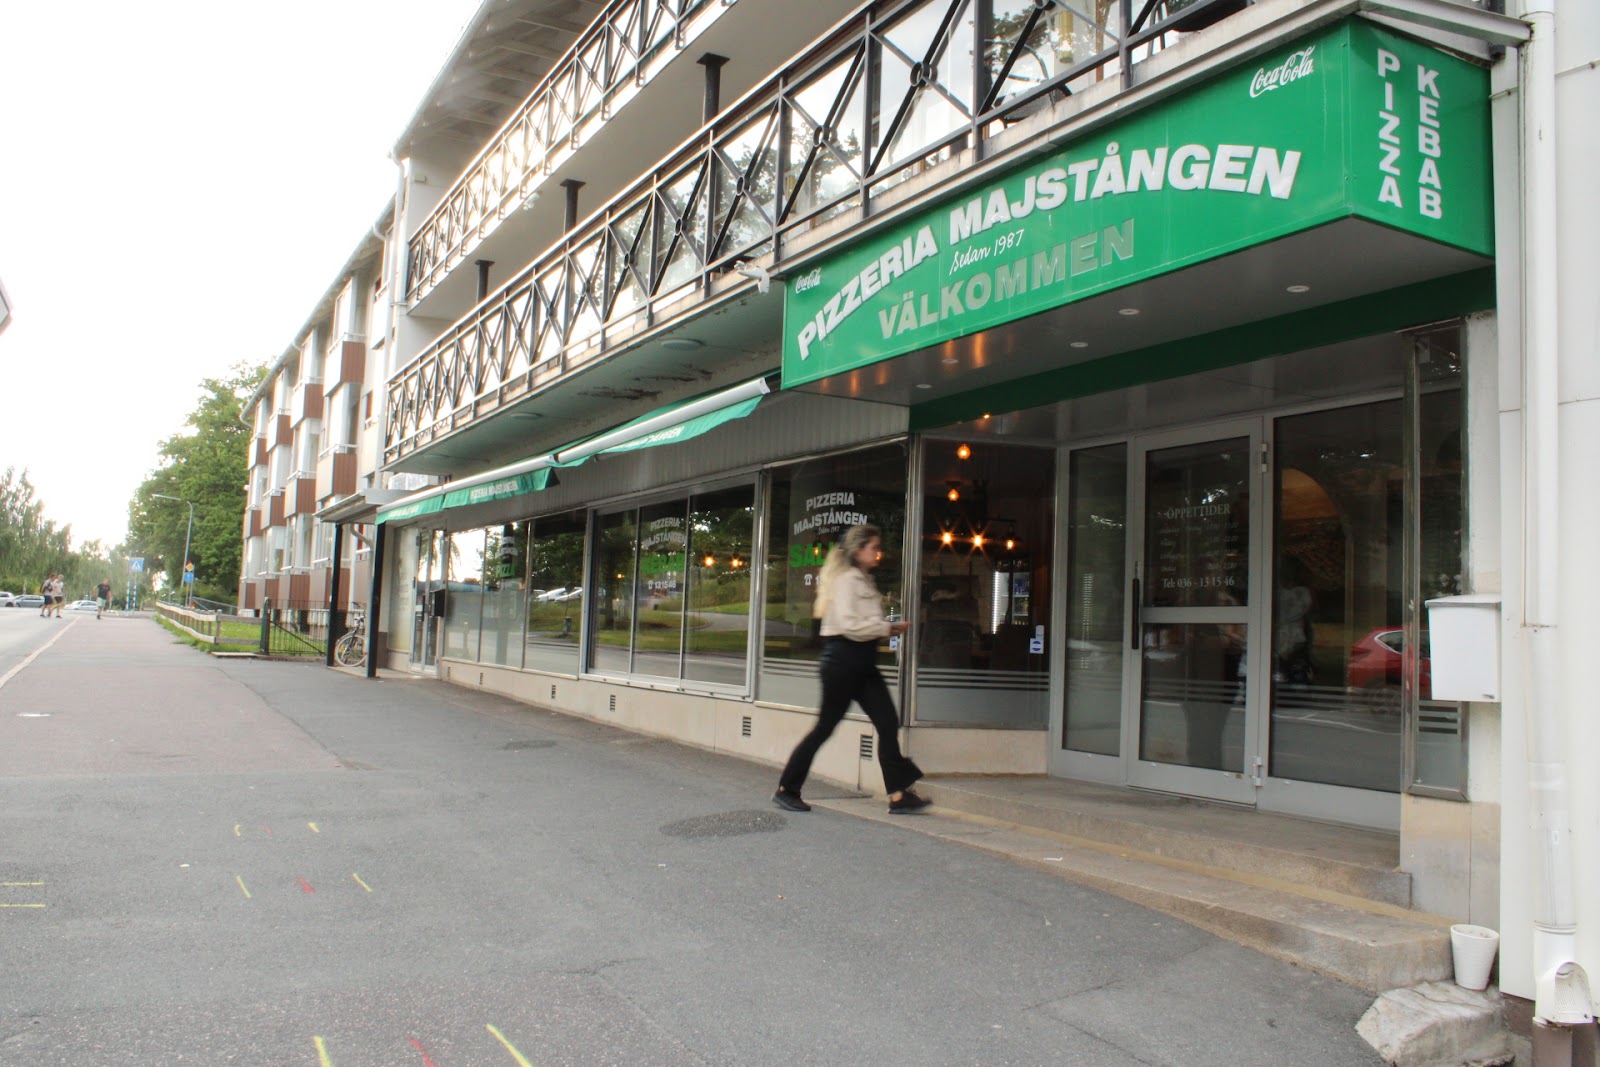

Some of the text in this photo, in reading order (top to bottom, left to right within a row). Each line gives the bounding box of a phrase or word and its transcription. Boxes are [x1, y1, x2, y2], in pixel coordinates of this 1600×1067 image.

[1249, 45, 1315, 98] Coca-Cola
[1377, 47, 1403, 208] PIZZA
[1417, 64, 1442, 220] KEBAB
[797, 141, 1302, 361] PIZZERIA MAJSTÅNGEN
[993, 229, 1024, 257] 1987
[795, 267, 822, 294] Coca-Cola
[878, 217, 1135, 340] VÄLKOMMEN
[806, 492, 855, 512] PIZZERIA
[1166, 503, 1231, 520] ÖPPETTIDER
[650, 517, 680, 531] PIZZERIA
[793, 507, 868, 535] MAJSTÅNGEN
[641, 528, 687, 549] MAJSTÅNGEN
[1177, 577, 1192, 588] 036
[1200, 576, 1209, 588] 13
[1213, 576, 1222, 587] 15
[1224, 576, 1235, 587] 46
